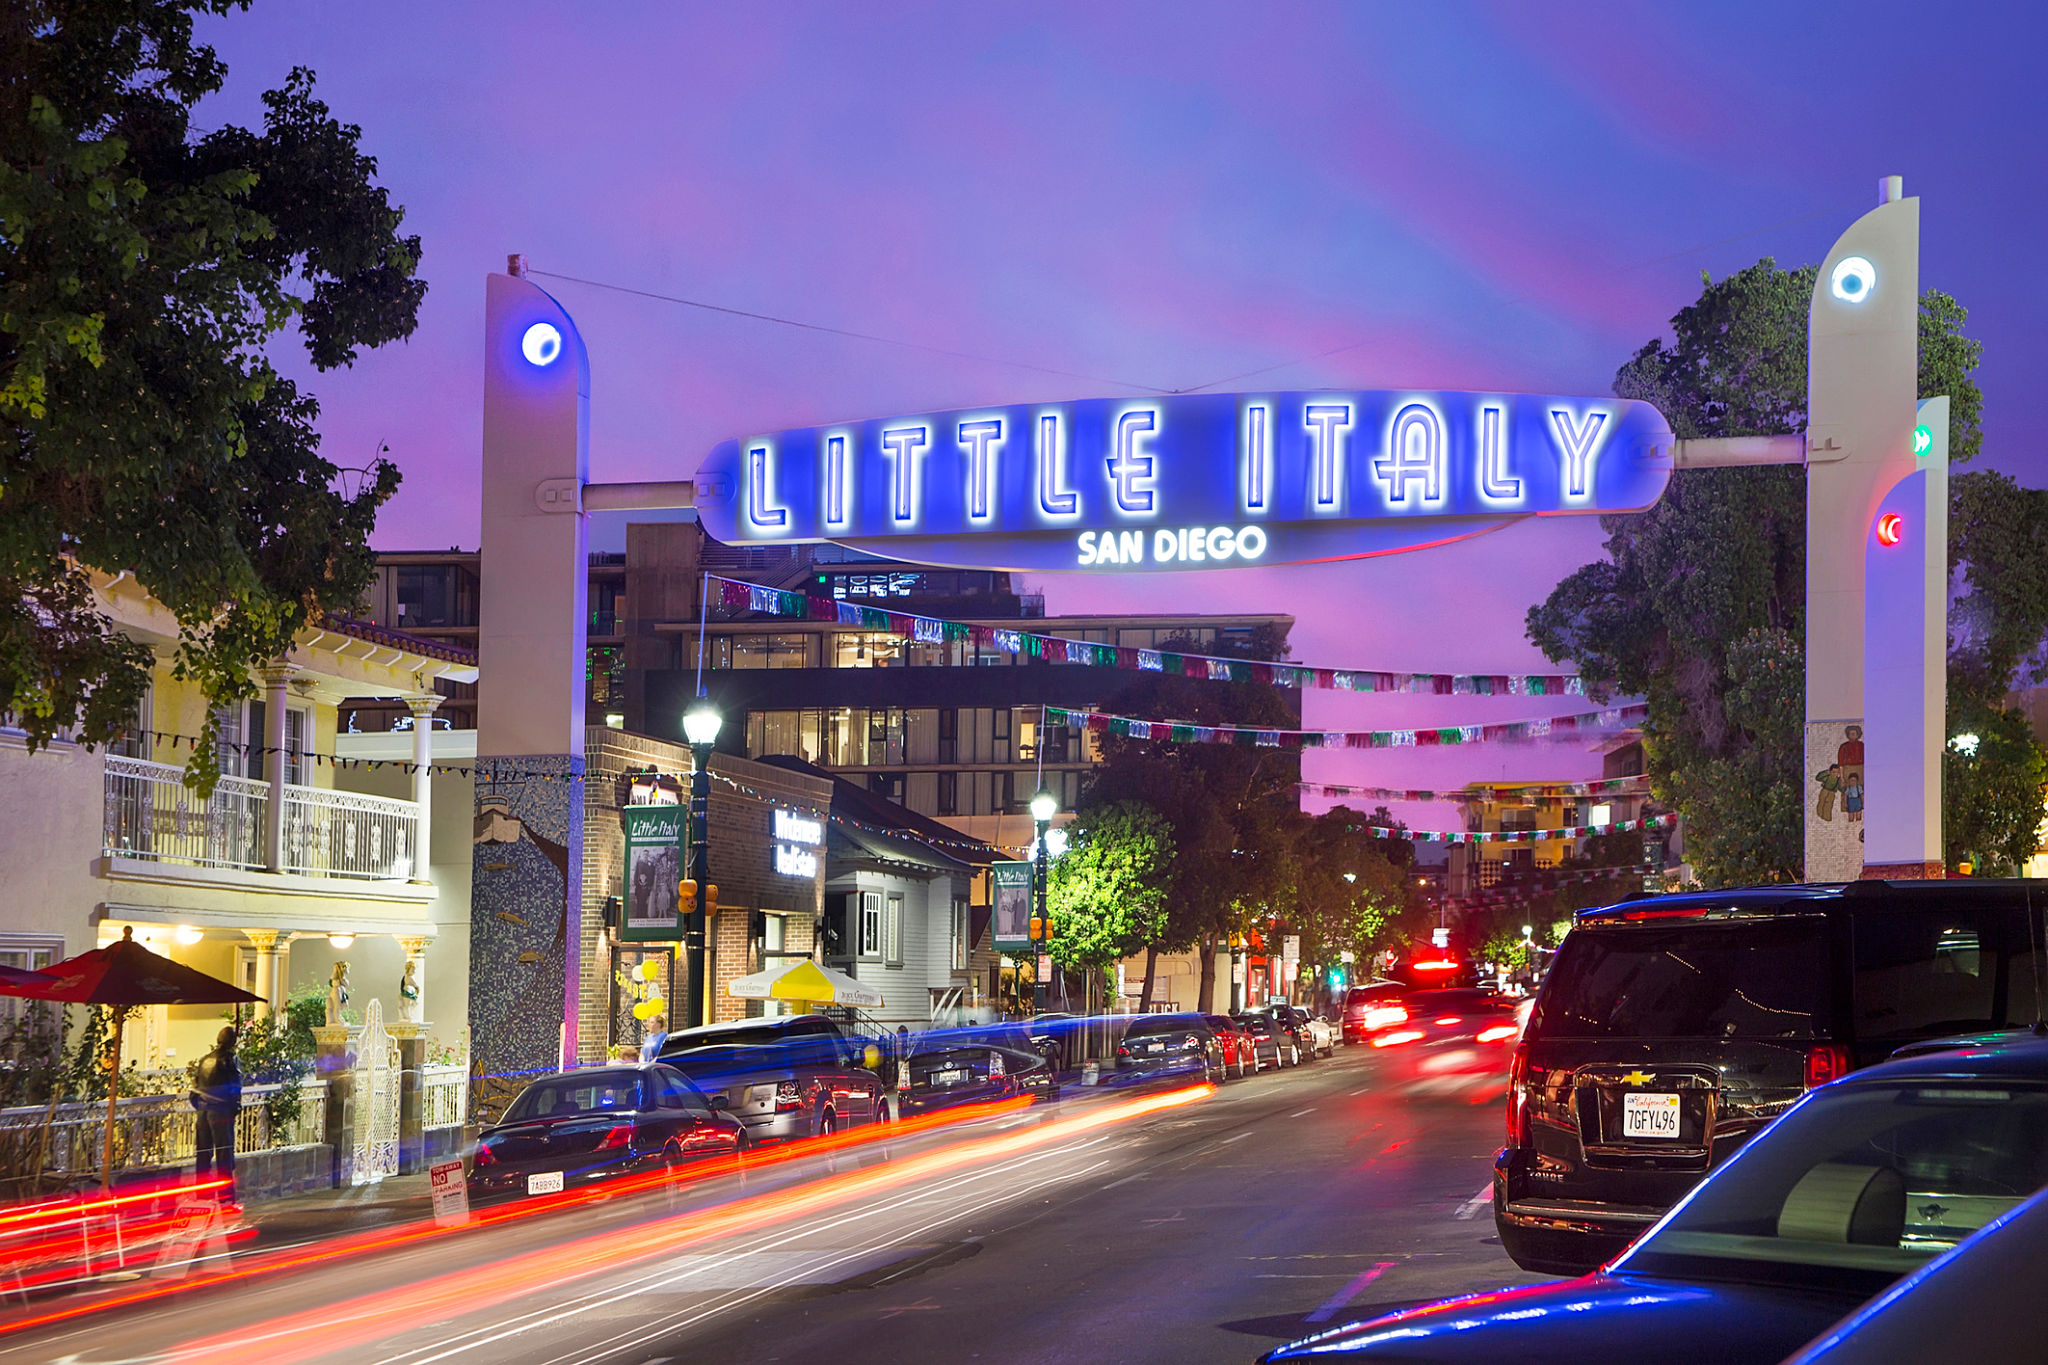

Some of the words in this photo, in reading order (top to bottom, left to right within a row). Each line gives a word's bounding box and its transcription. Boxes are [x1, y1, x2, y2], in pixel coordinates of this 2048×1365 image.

[749, 410, 1156, 527] LITTLE
[1248, 403, 1608, 508] ITALY
[1077, 530, 1144, 565] SAN
[1153, 525, 1267, 562] DIEGO
[631, 814, 658, 836] Little
[658, 812, 680, 841] Italy
[1627, 1109, 1676, 1131] 7GFY496
[433, 1173, 447, 1186] NO
